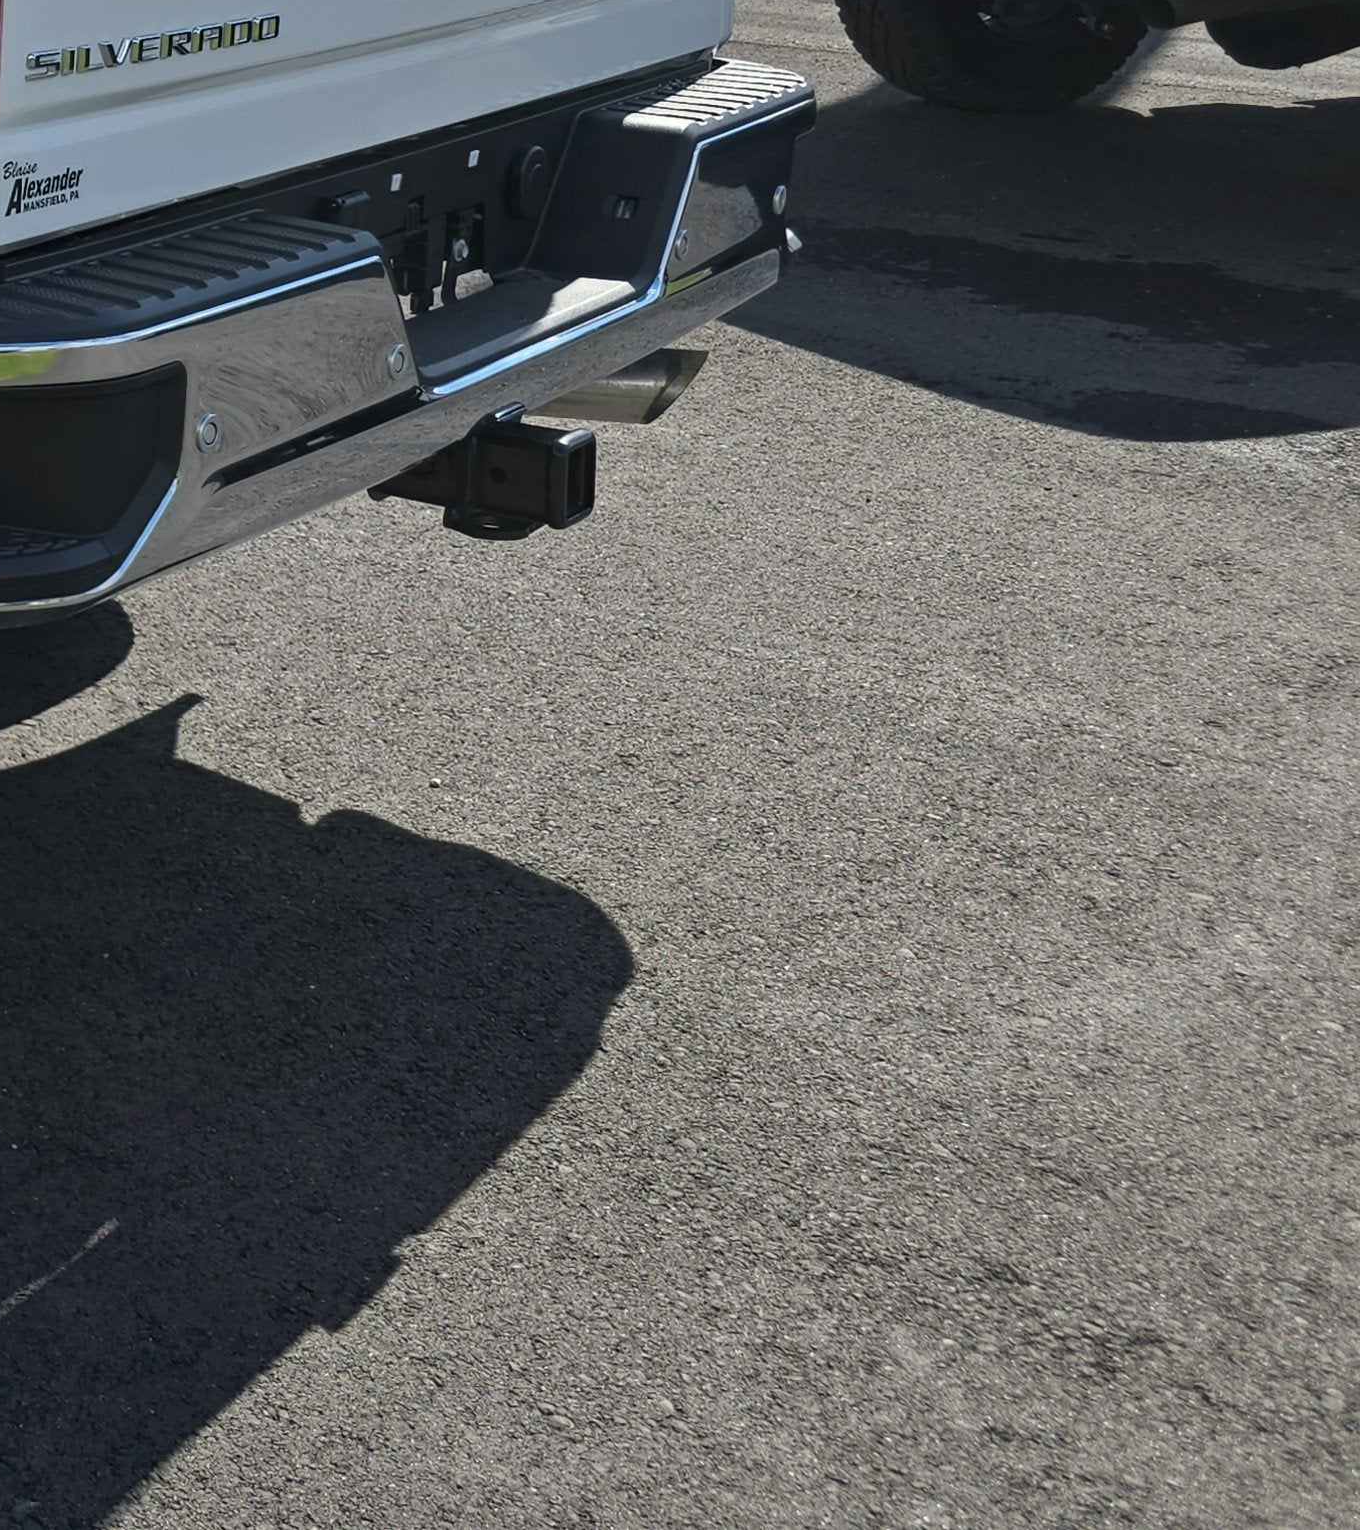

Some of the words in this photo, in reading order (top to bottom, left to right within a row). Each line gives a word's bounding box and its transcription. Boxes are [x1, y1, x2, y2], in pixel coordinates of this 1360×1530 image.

[25, 12, 281, 82] SILVERADO
[3, 160, 38, 180] Blaise
[5, 167, 84, 217] Alexander
[23, 192, 68, 212] MANSFIELD,
[70, 189, 80, 201] PA
